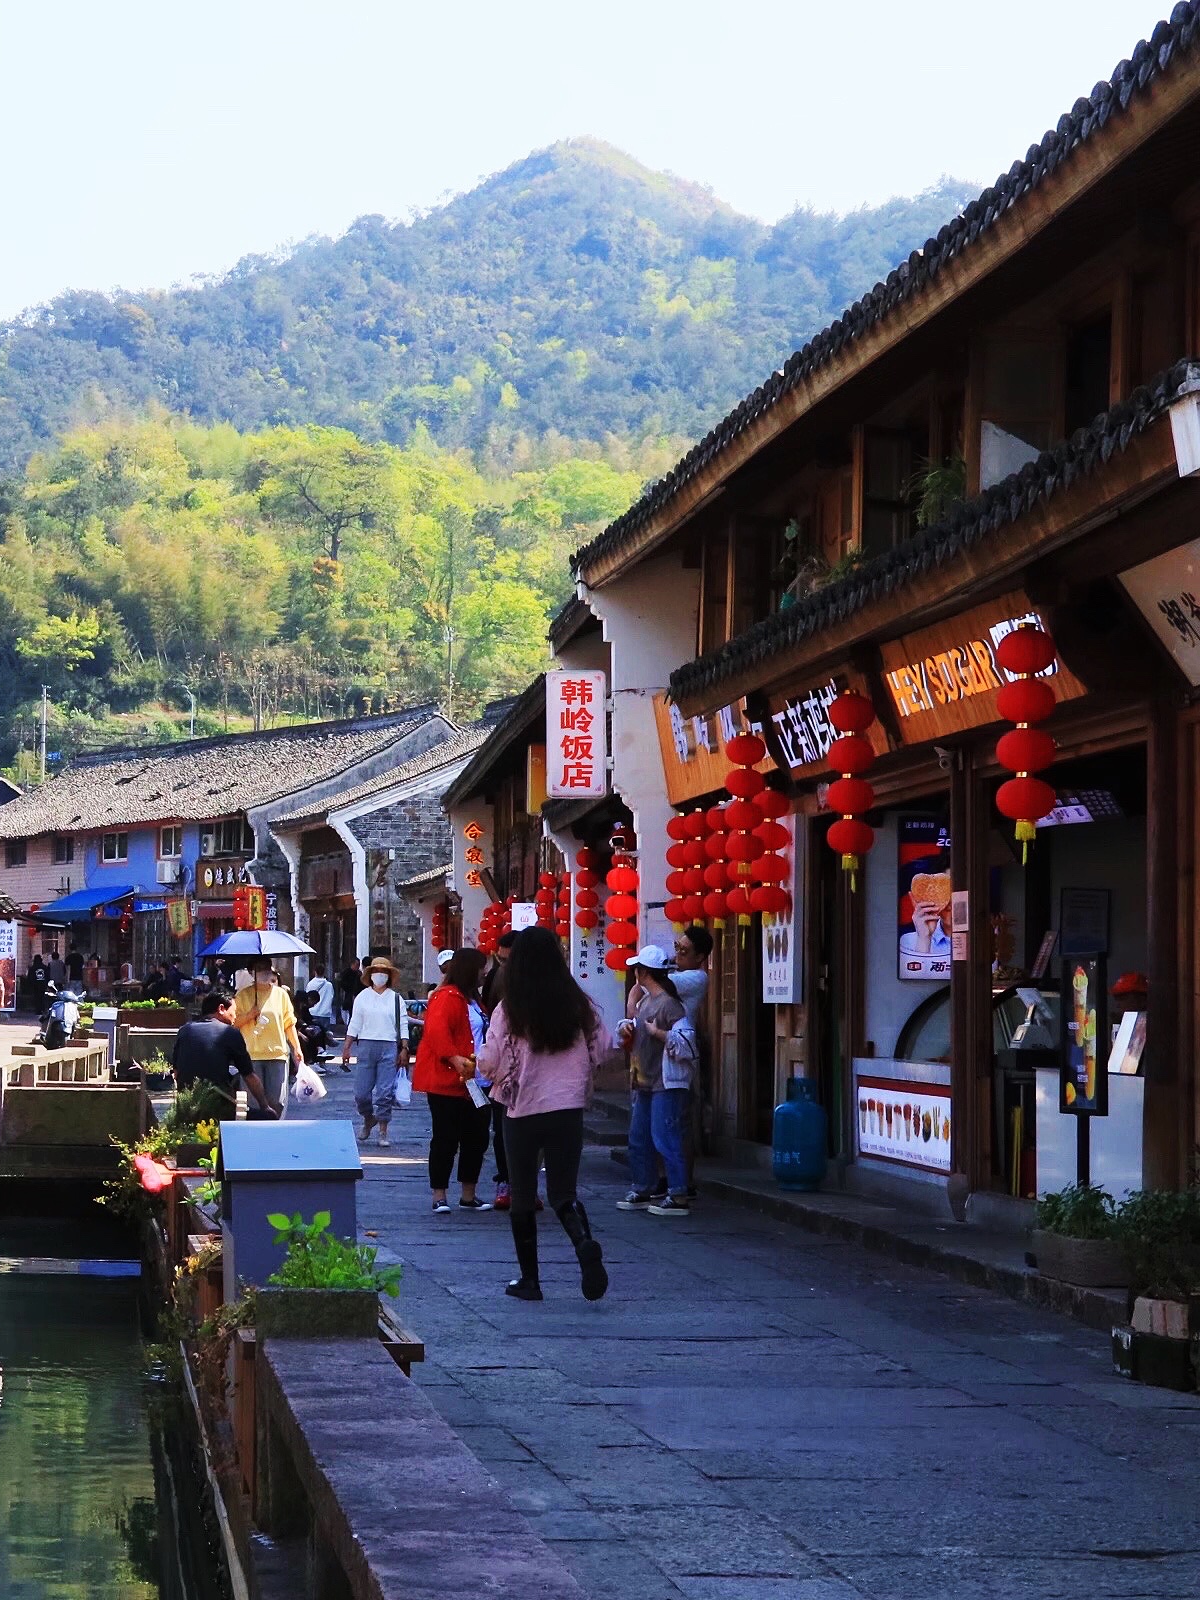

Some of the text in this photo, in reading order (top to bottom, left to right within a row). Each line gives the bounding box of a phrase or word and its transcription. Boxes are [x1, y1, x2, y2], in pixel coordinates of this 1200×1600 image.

[886, 661, 934, 717] HEY
[925, 639, 1004, 704] SUGAR
[560, 679, 595, 789] 韩岭饭店
